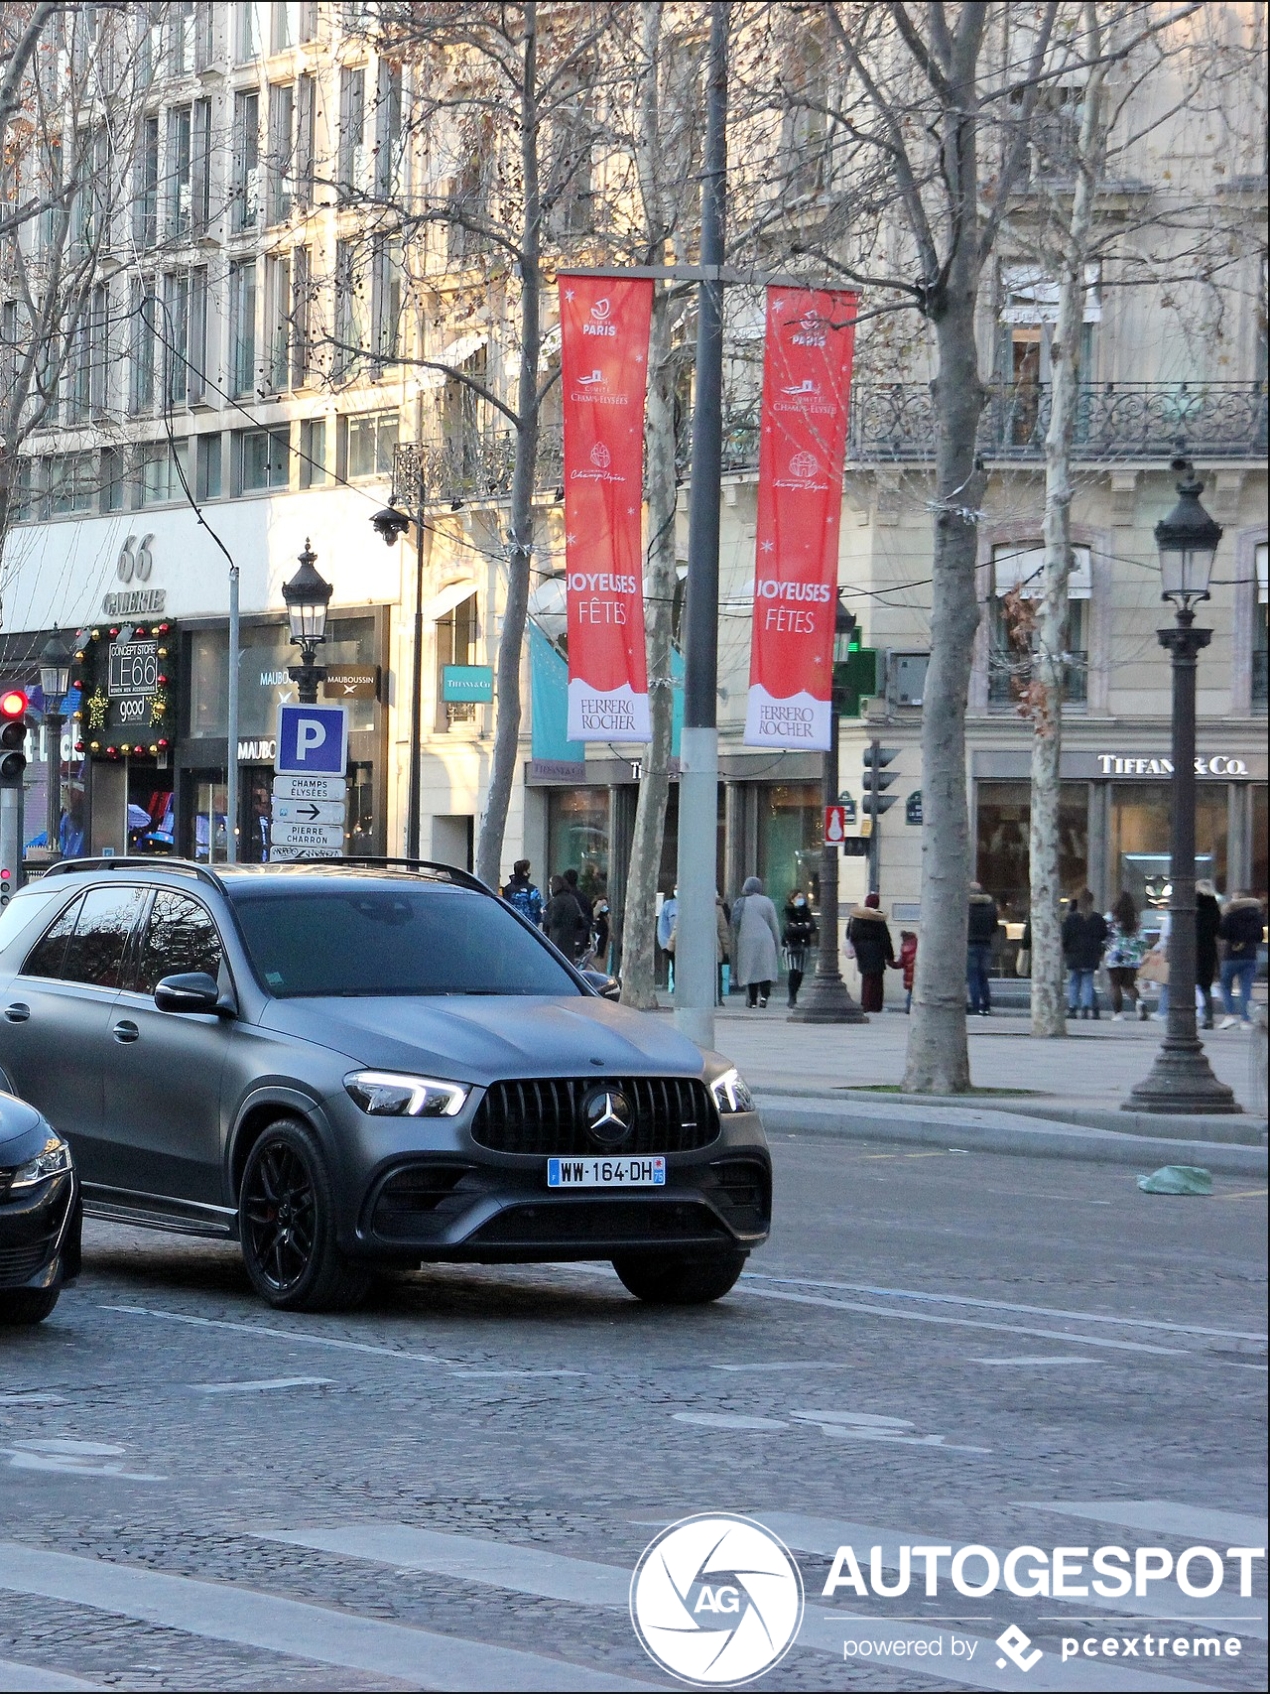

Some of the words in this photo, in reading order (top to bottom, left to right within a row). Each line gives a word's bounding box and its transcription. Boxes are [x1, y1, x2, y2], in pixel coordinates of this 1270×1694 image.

[583, 324, 616, 336] PARIS
[792, 335, 827, 347] PARIS
[117, 533, 155, 583] 66
[567, 573, 636, 594] JOYEUSES
[756, 580, 831, 602] JOYEUSES
[579, 597, 626, 625] FÊTES
[765, 605, 815, 634] FÊTES
[111, 645, 137, 657] CONCEPT
[137, 643, 156, 655] STORE
[327, 676, 373, 684] MAUBOUSSIN
[119, 696, 144, 722] good
[581, 699, 634, 714] FERRERO
[760, 704, 814, 722] FERRERO
[582, 714, 636, 731] ROCHER
[759, 720, 814, 738] ROCHER
[296, 719, 327, 761] P
[290, 788, 328, 797] ÉLYSÉES
[292, 780, 328, 789] CHAMPS
[286, 835, 328, 844] CHARRON
[292, 827, 324, 836] PIERRE
[560, 1161, 652, 1182] WW-164-DH
[654, 1172, 663, 1183] 75
